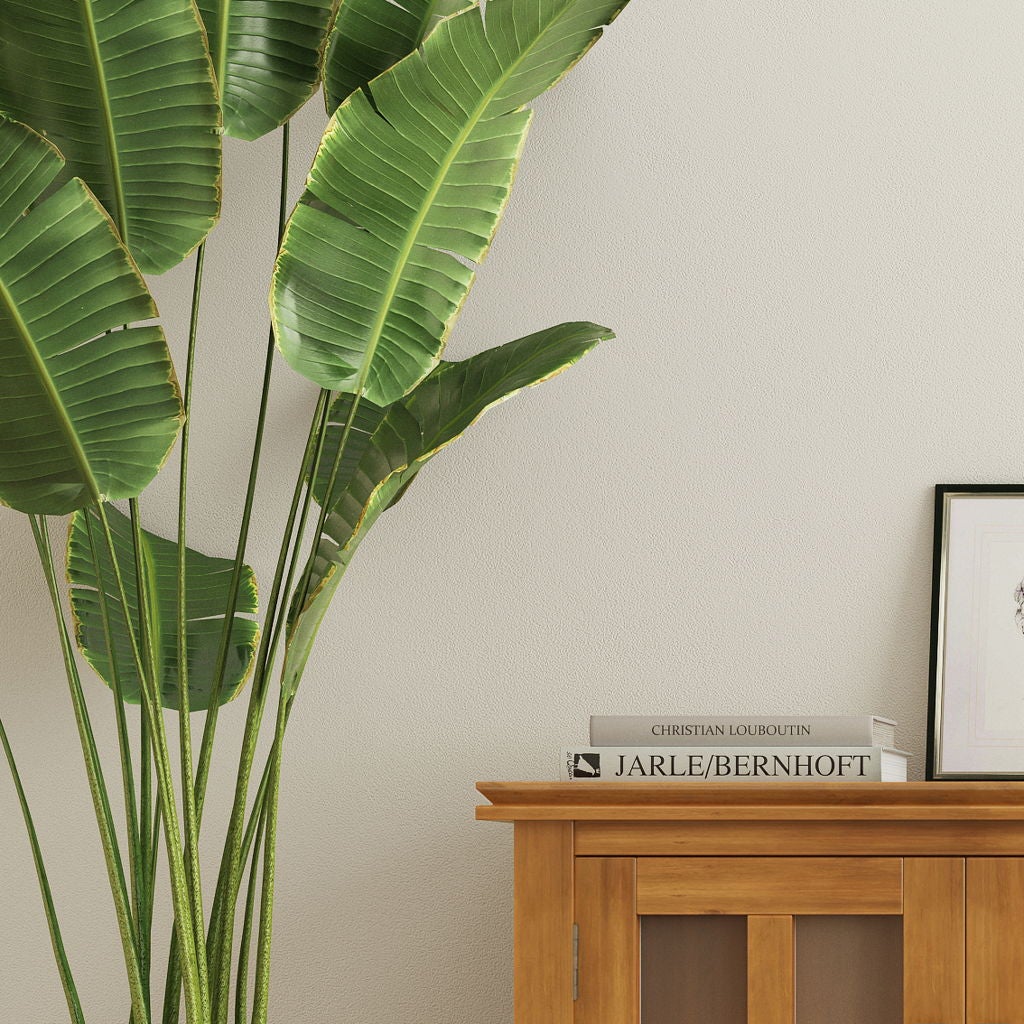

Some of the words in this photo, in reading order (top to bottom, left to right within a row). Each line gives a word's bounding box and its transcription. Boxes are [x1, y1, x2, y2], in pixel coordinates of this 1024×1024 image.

[652, 724, 725, 736] CHRISTIAN
[729, 724, 811, 736] LOUBOUTIN
[615, 754, 871, 779] JARLE/BERNHOFT
